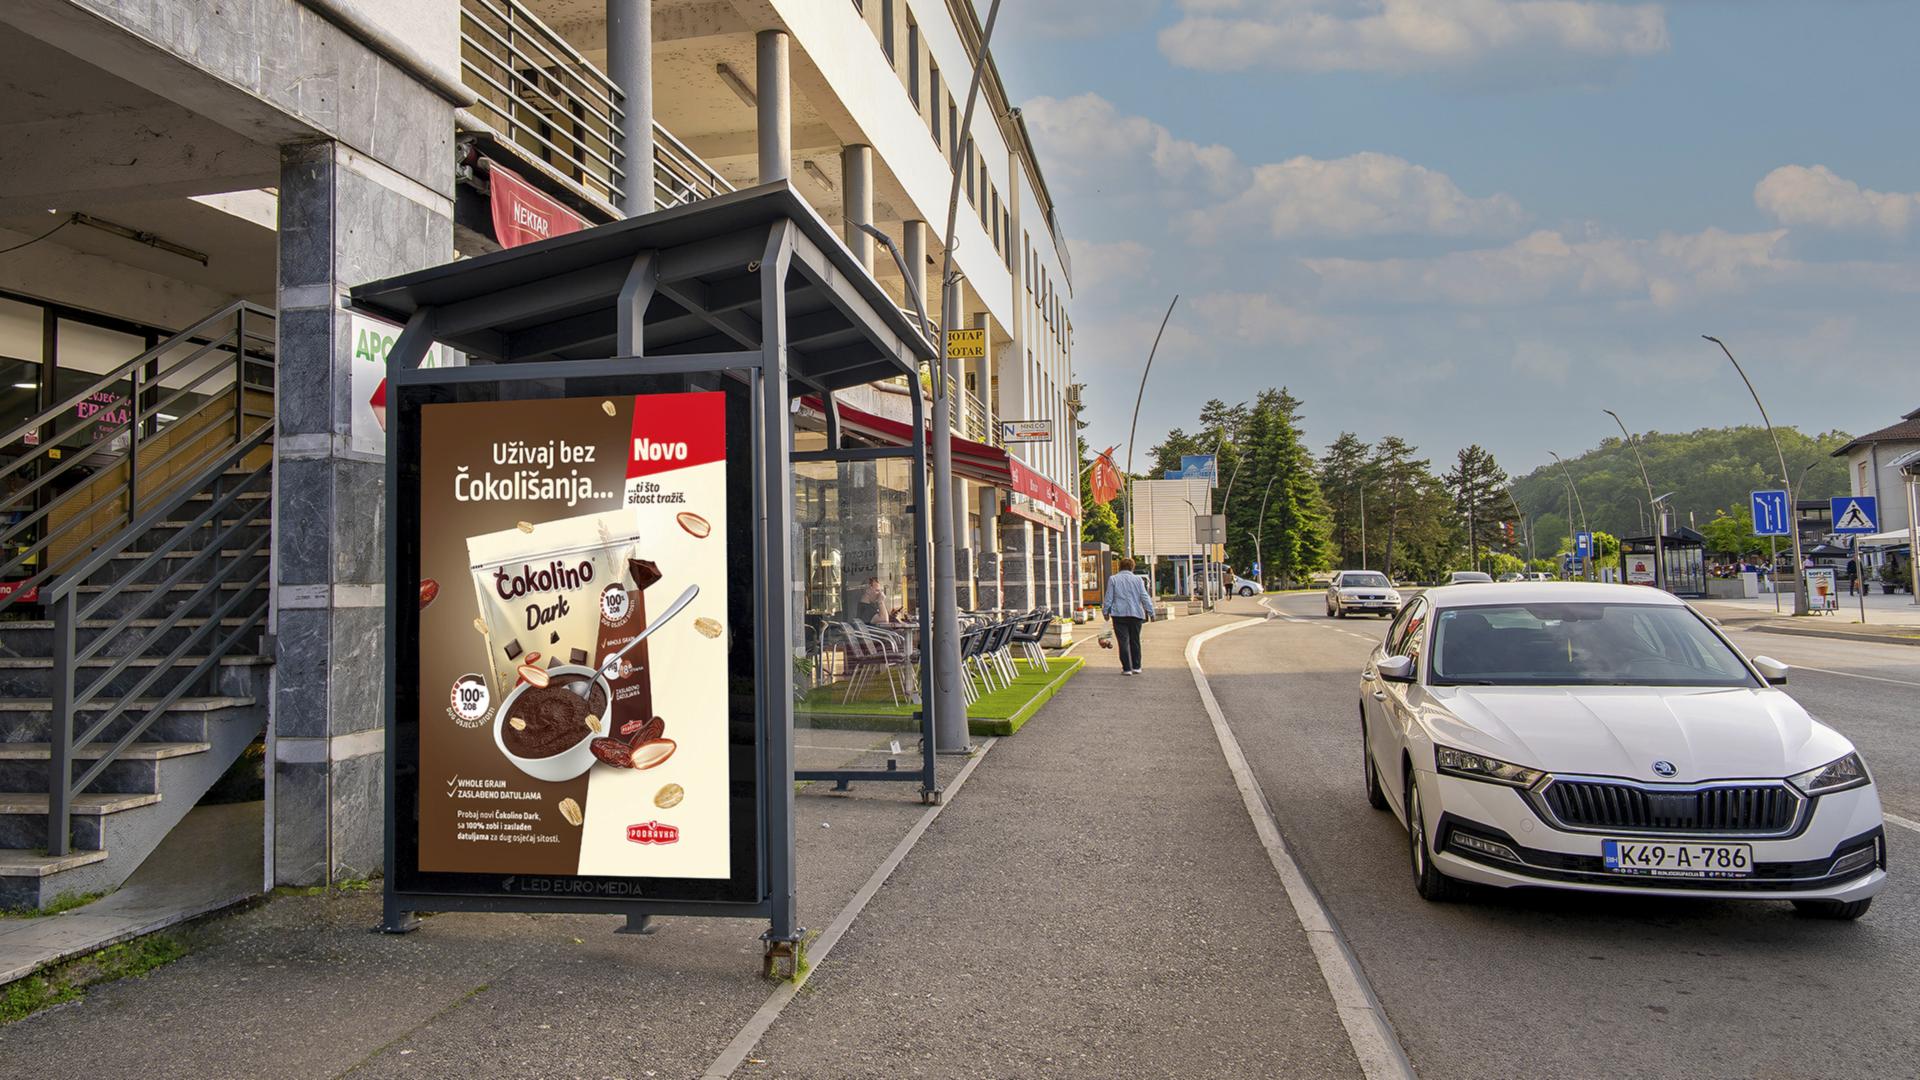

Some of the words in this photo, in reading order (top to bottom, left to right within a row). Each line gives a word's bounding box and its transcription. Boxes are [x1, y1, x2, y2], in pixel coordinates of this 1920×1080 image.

[513, 201, 550, 238] NEKTAR
[493, 440, 555, 470] Uživaj
[560, 440, 596, 463] bez
[634, 437, 688, 461] Novo
[454, 465, 614, 507] Čokolišanja...
[644, 481, 661, 493] što
[628, 493, 656, 504] sitost
[656, 492, 686, 504] tražiš.
[492, 560, 594, 600] Čokolino
[525, 594, 570, 631] Dark
[462, 702, 477, 711] ZOB
[458, 779, 484, 788] WHOLE
[484, 779, 507, 788] GRAIN
[458, 790, 500, 799] ZASLAĐENO
[500, 791, 542, 801] DATULJAMA
[457, 810, 479, 820] Probaj
[480, 811, 495, 819] novi
[495, 809, 523, 820] Čokolino
[523, 811, 542, 821] Dark,
[466, 822, 485, 830] 100%
[485, 822, 500, 830] zobi
[503, 822, 533, 831] zaslađen
[457, 831, 490, 842] datuljama
[499, 832, 512, 843] dug
[512, 833, 536, 844] osjećaj
[536, 834, 561, 844] sitosti.
[631, 829, 675, 838] PODRAVKA
[1621, 845, 1746, 869] K49-A-786
[520, 879, 550, 892] LED
[553, 880, 594, 893] EURO
[597, 881, 643, 895] MEDIA
